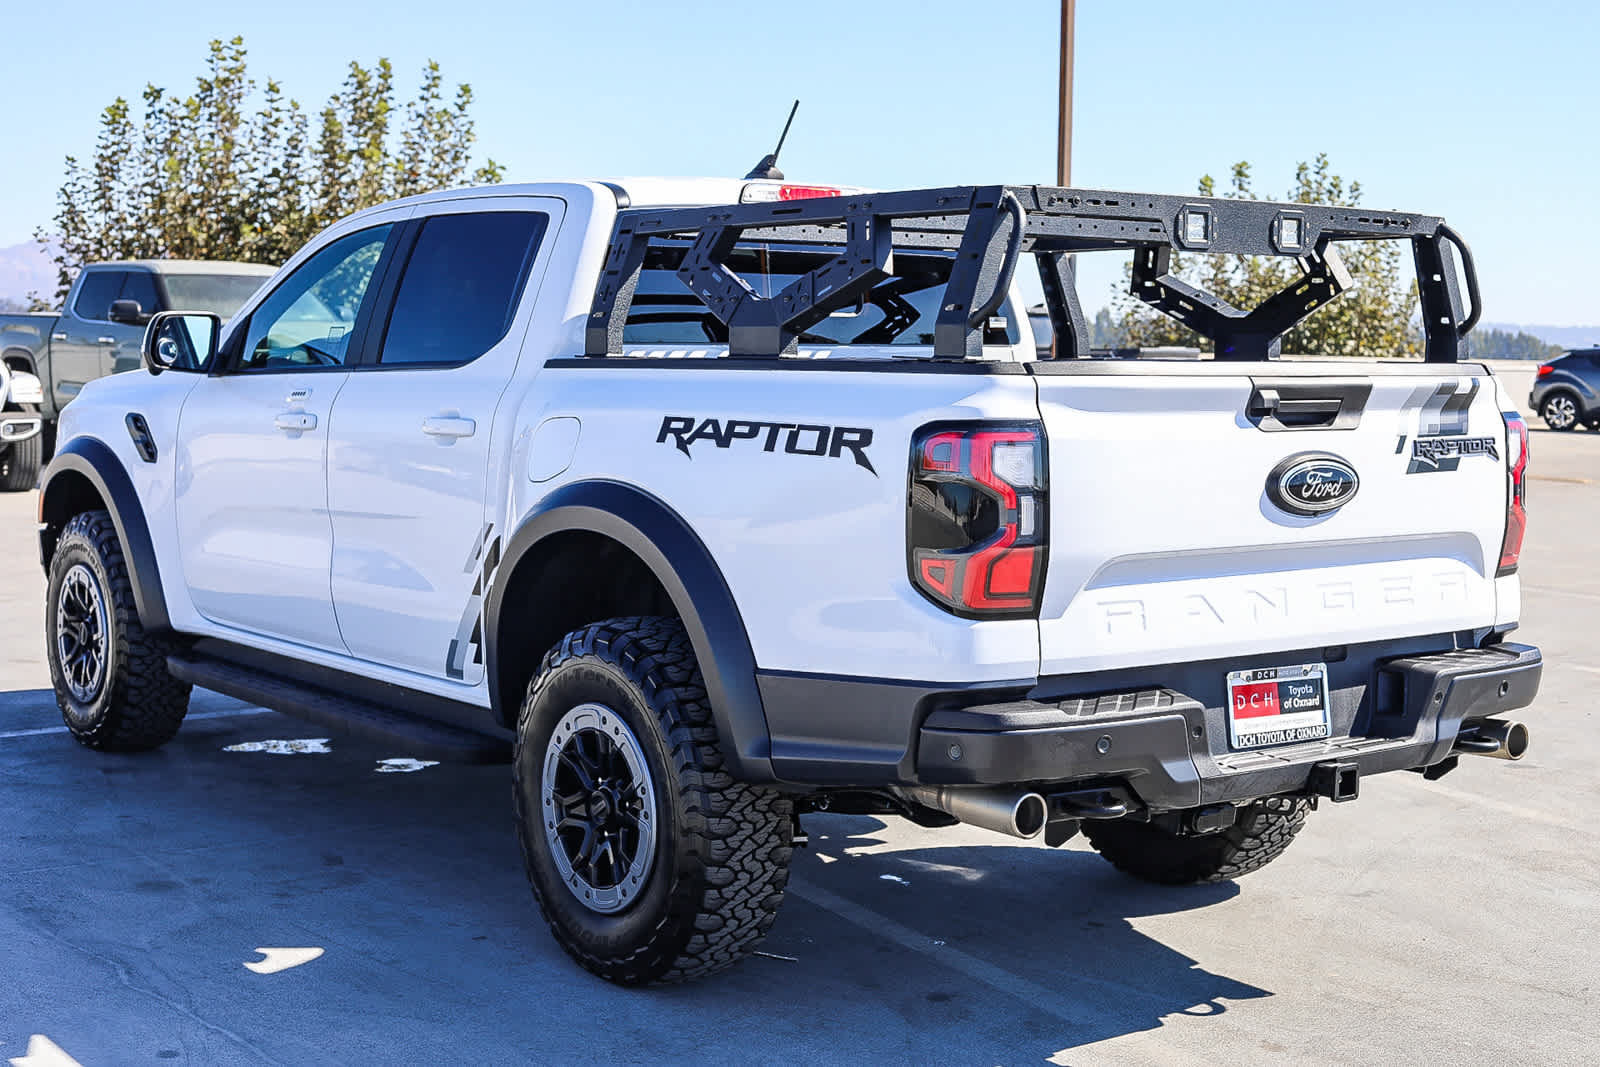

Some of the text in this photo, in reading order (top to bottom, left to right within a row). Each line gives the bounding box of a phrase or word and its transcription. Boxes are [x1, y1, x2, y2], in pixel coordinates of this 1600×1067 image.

[656, 416, 879, 479] RAPTOR
[1412, 436, 1499, 468] RAPTOR
[1302, 471, 1342, 498] Ford
[1097, 570, 1470, 634] RANGER
[1257, 670, 1275, 679] DCH
[1237, 691, 1273, 710] DCH
[1288, 684, 1313, 697] Toyota
[1284, 695, 1320, 709] of Oxnard
[1239, 725, 1326, 747] DCH TOYOTA OF OXNARD
